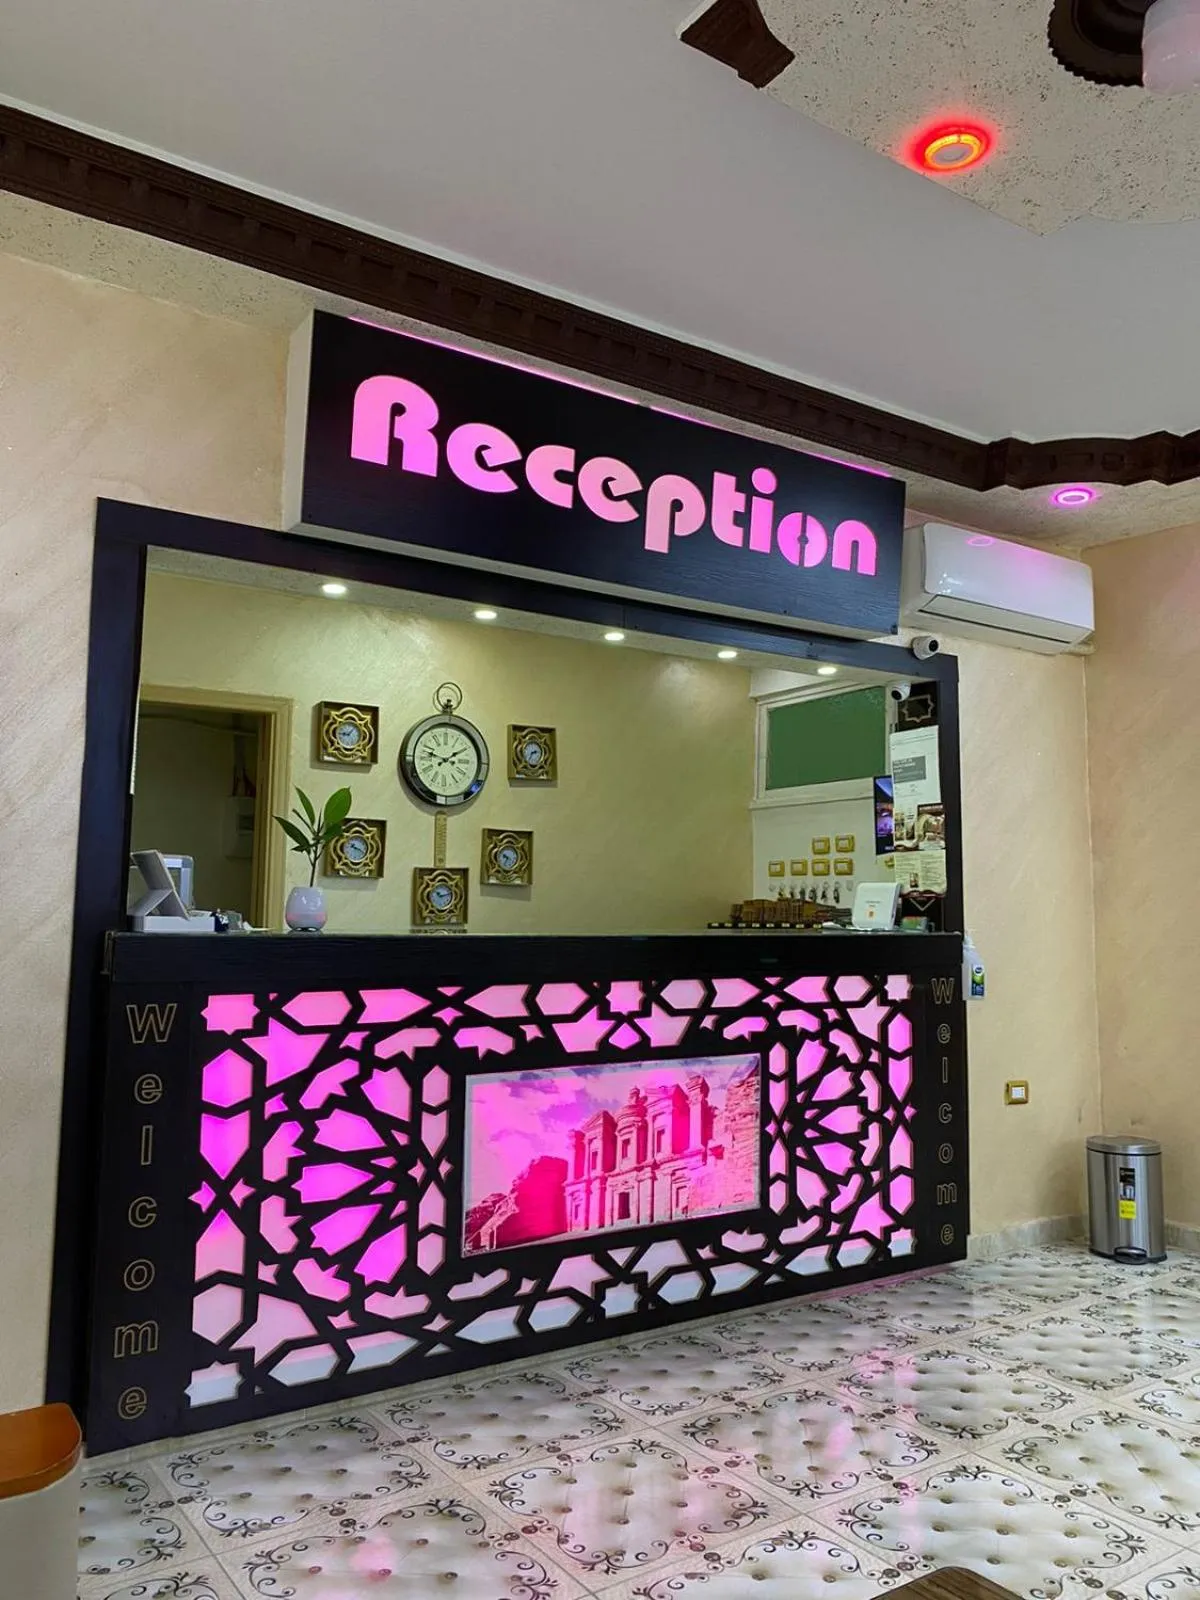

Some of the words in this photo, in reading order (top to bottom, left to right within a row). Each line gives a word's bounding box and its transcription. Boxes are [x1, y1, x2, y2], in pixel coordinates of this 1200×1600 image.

[351, 375, 877, 576] Reception
[114, 1003, 177, 1420] Welcome
[931, 977, 958, 1245] Welcome
